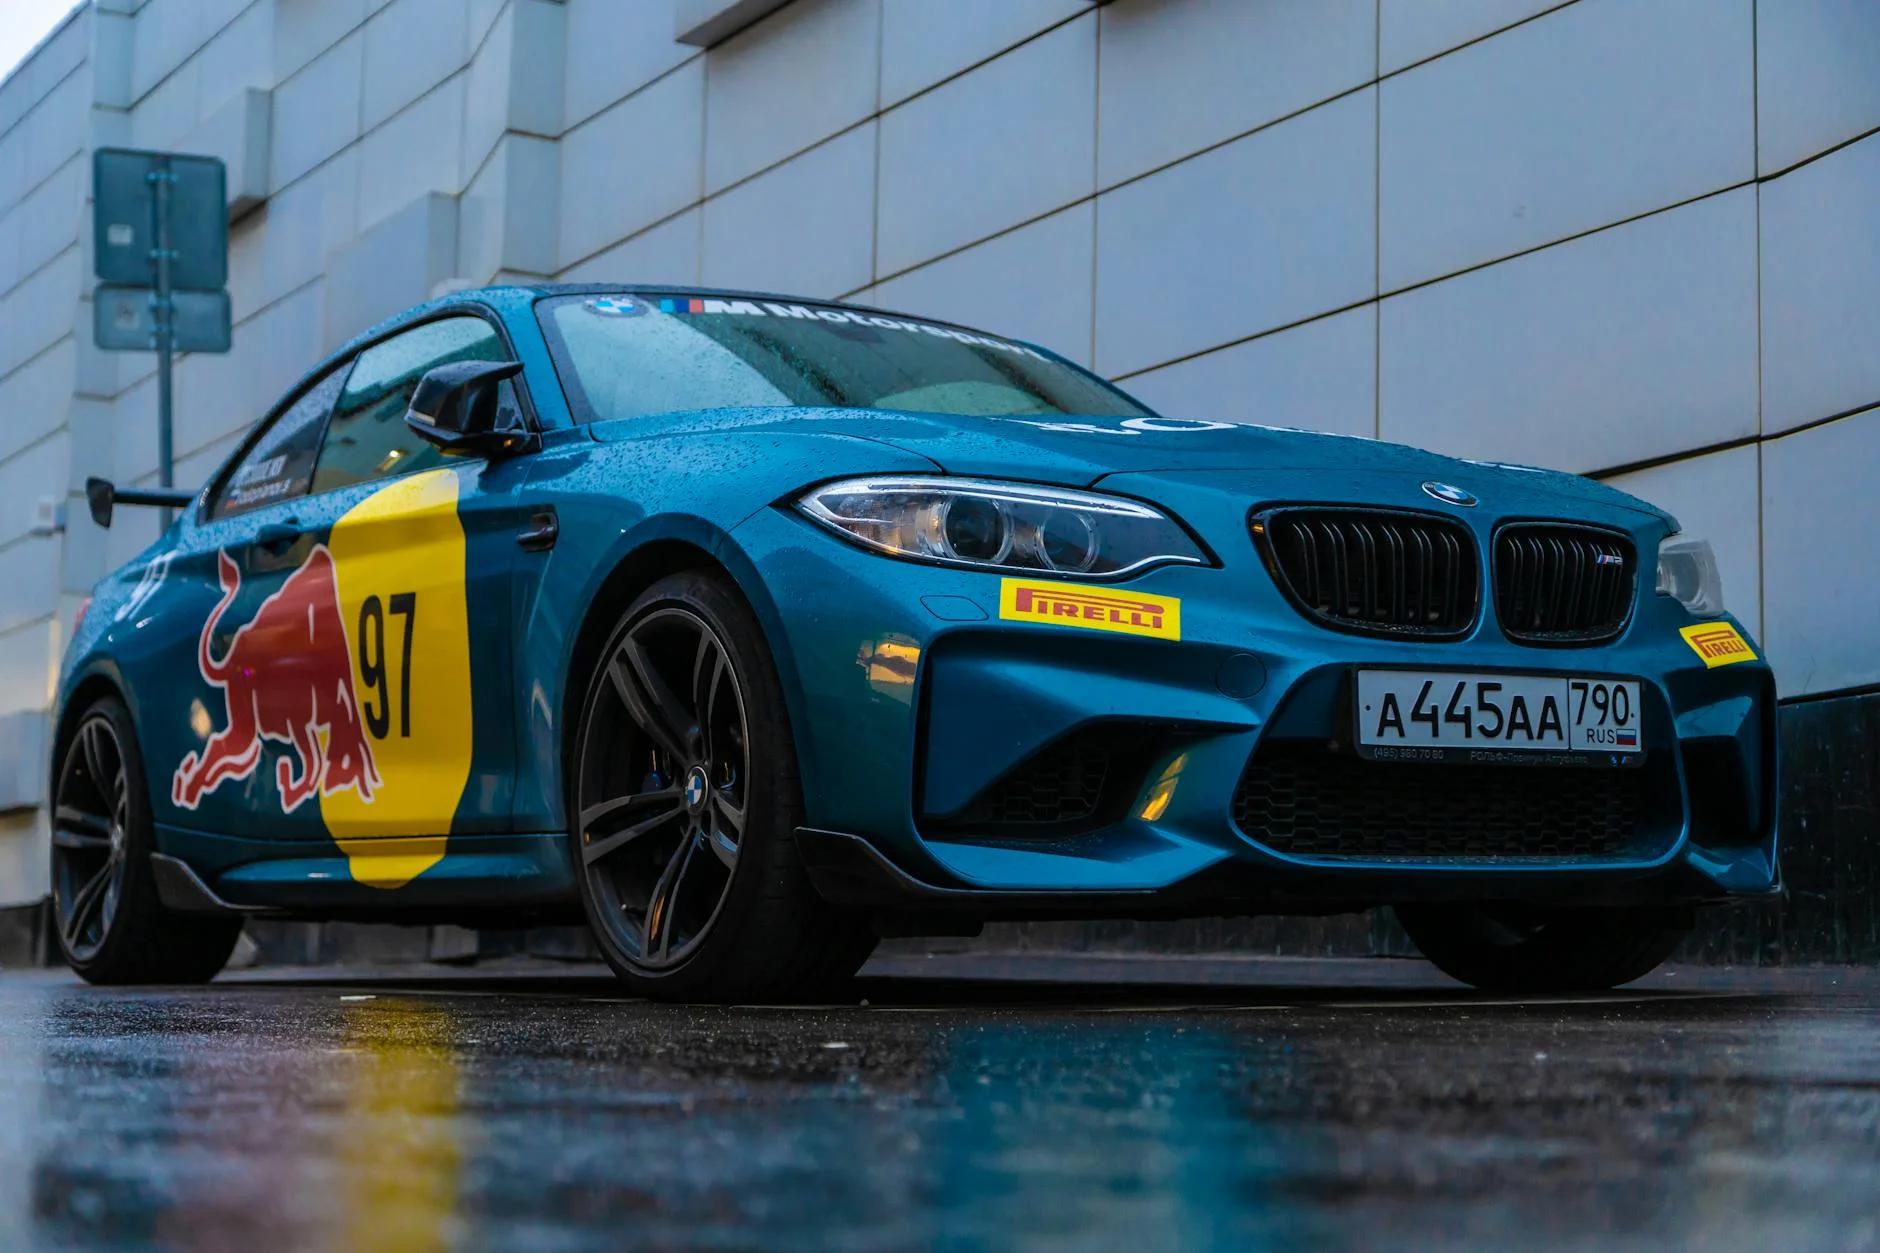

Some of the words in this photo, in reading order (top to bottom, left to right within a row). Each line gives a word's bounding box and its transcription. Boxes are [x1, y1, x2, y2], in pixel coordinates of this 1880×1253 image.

[1015, 587, 1165, 629] PIRELLI
[1690, 629, 1747, 658] PIRELLI
[358, 592, 416, 740] 97
[1571, 682, 1630, 727] 790
[1586, 728, 1615, 744] RUS
